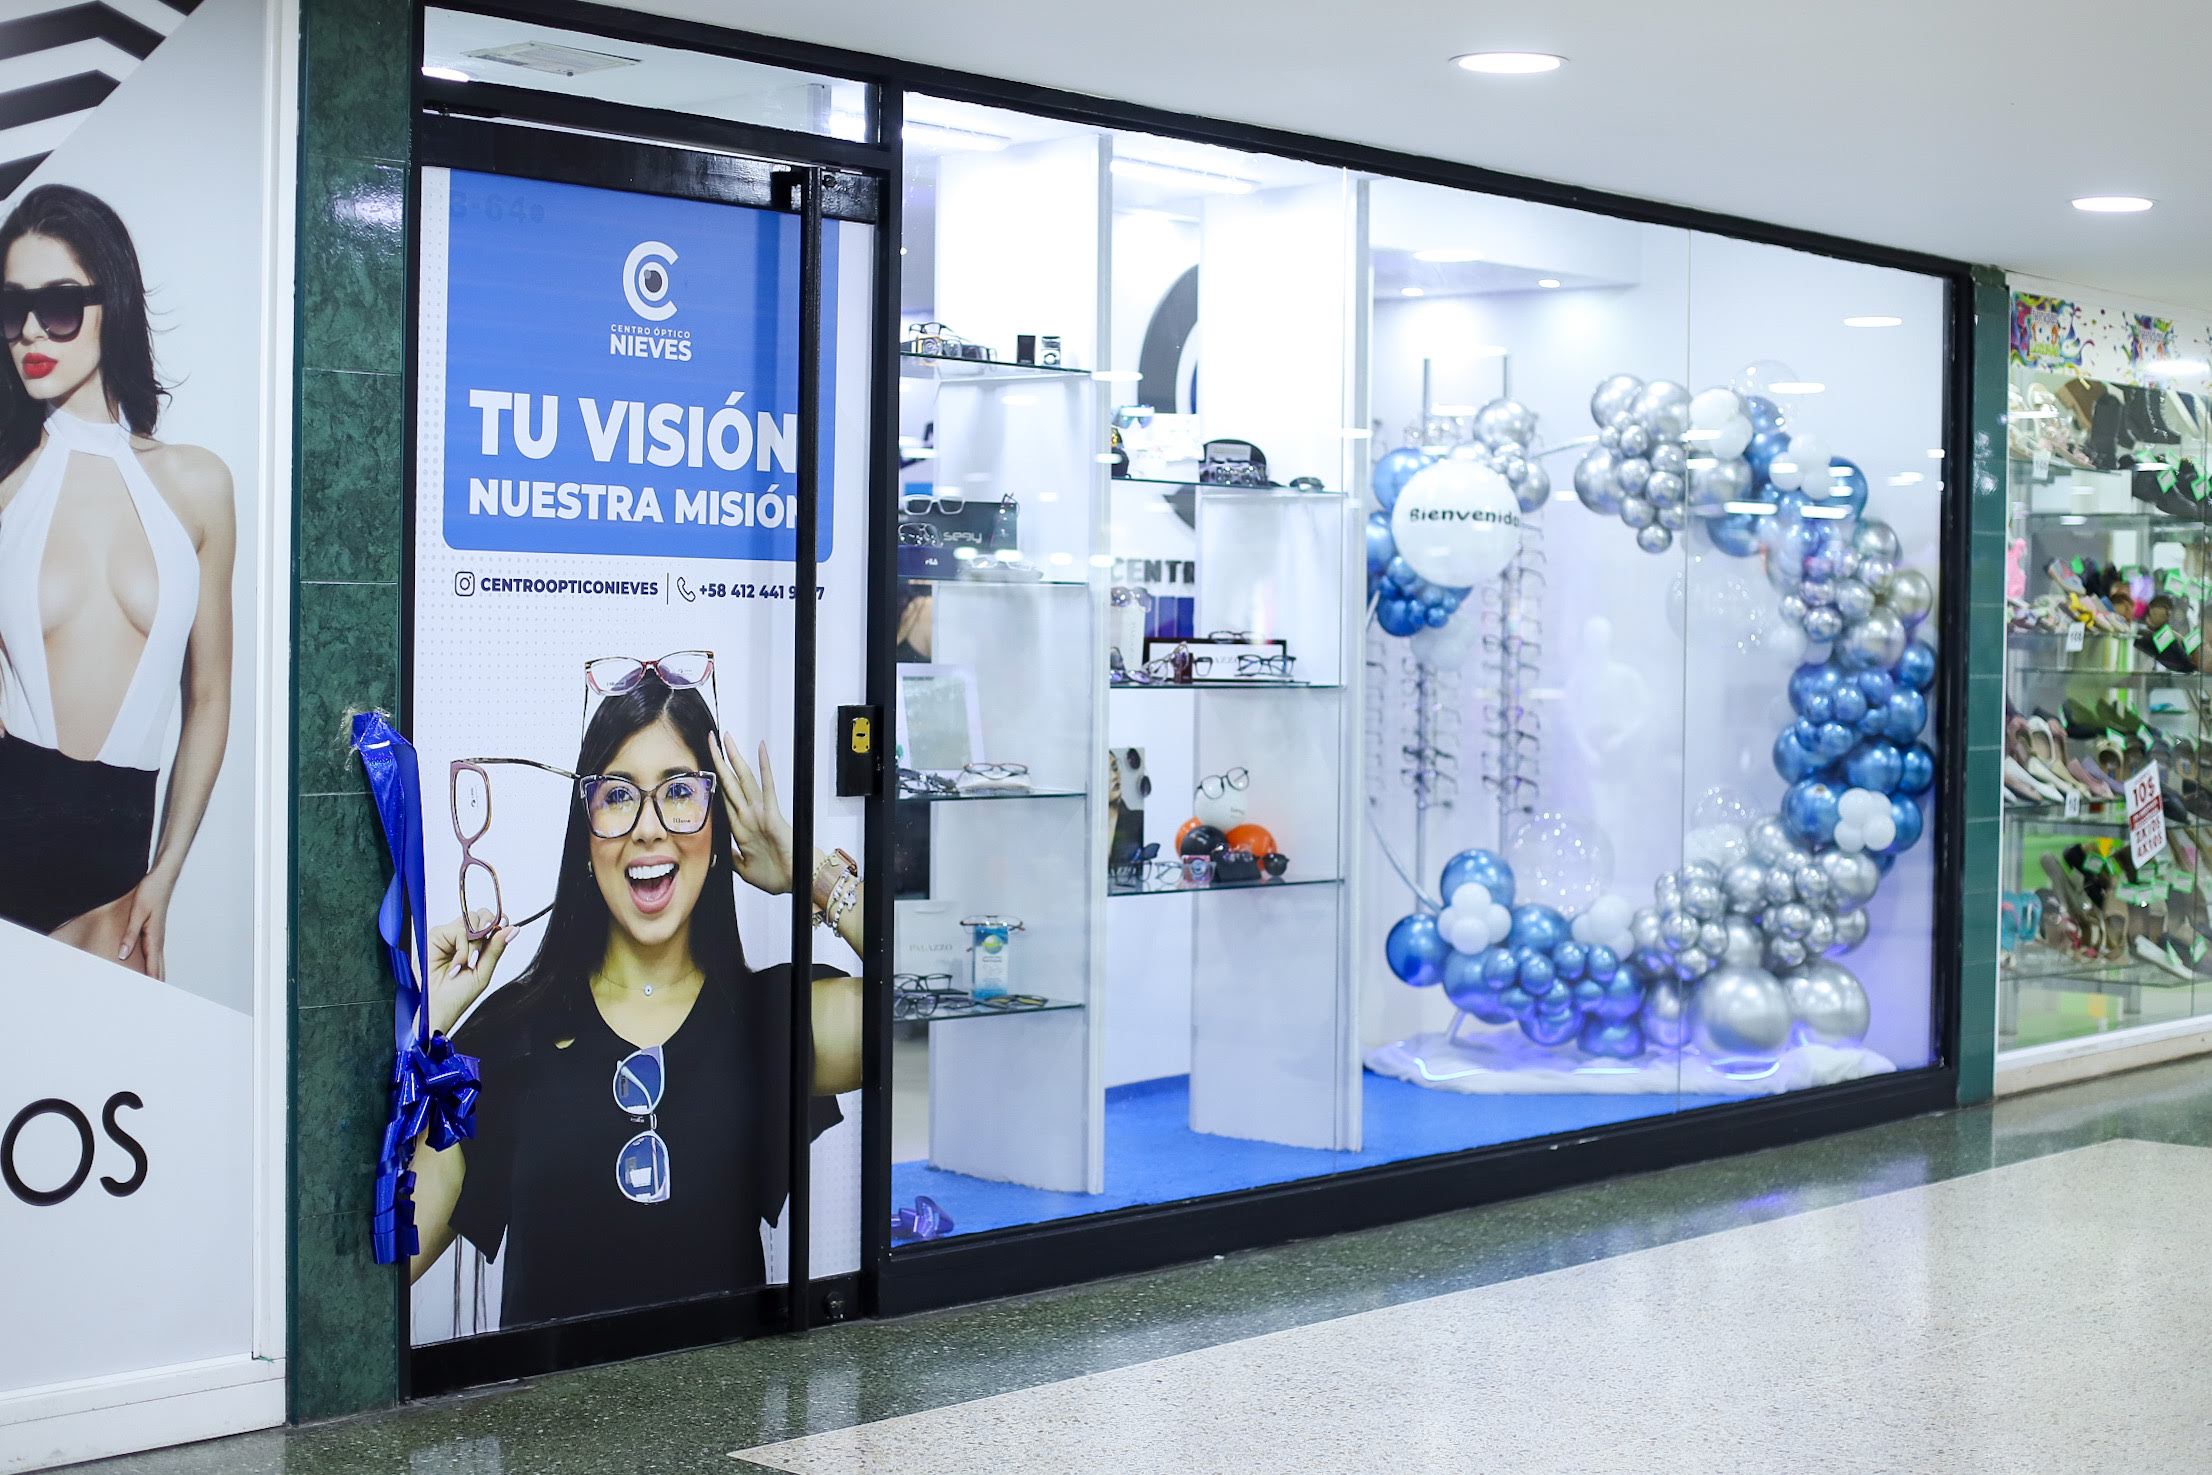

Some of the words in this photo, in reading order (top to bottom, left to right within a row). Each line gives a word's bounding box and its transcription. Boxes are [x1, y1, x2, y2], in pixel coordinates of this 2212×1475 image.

[610, 324, 651, 335] CENTRO
[653, 327, 691, 339] ÓPTICO
[610, 333, 692, 362] NIEVES
[469, 389, 559, 460] TU
[578, 391, 797, 473] VISIÓN
[469, 477, 664, 523] NUESTRA
[480, 577, 659, 596] CENTROOPTICONIEVES
[699, 583, 726, 598] +58
[731, 584, 755, 599] 412
[759, 585, 784, 599] 441
[1, 1091, 148, 1207] OS
